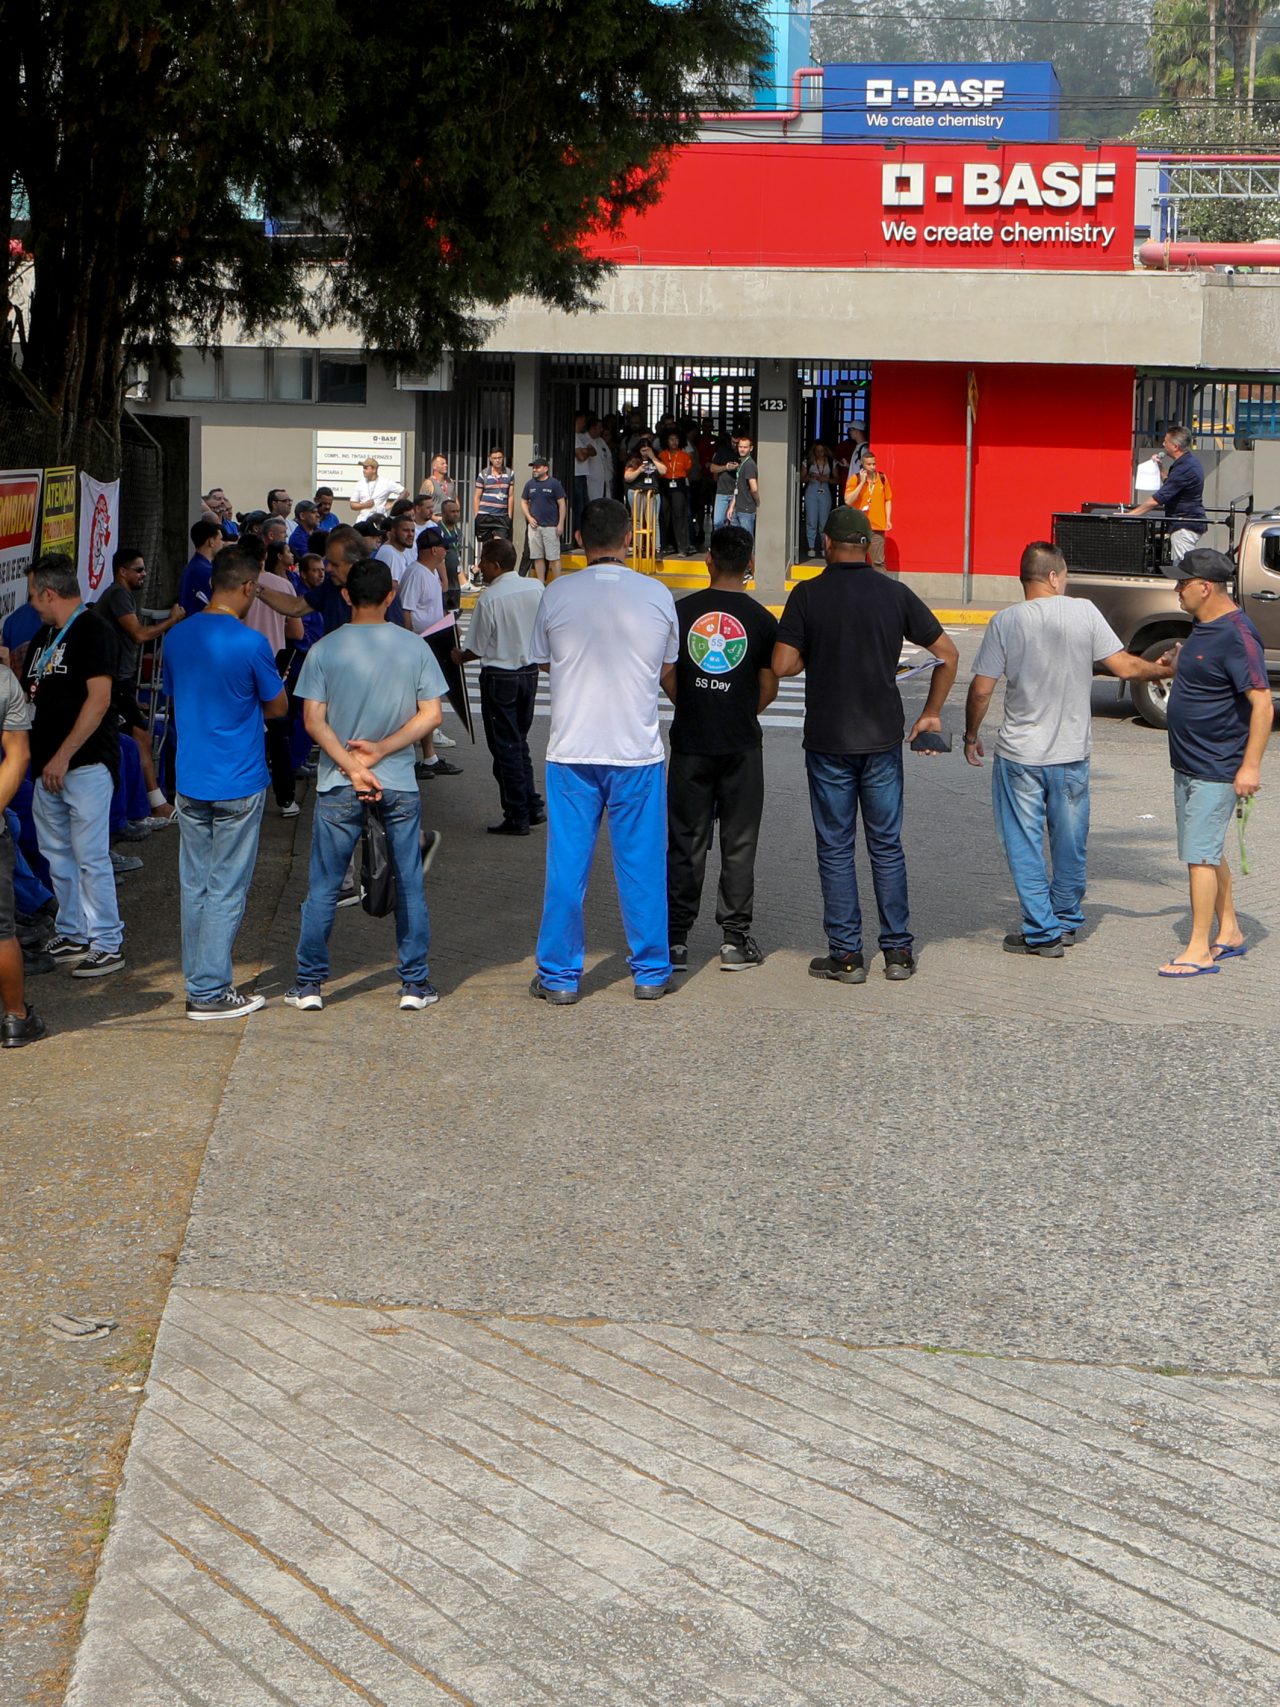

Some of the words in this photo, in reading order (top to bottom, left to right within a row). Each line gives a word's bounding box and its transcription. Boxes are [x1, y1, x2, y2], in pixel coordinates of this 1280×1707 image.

[913, 79, 1005, 108] BASF
[866, 114, 888, 128] We
[892, 114, 934, 128] create
[937, 113, 1004, 130] chemistry
[963, 161, 1117, 208] BASF
[881, 220, 917, 242] We
[923, 221, 994, 243] create
[1000, 221, 1116, 247] chemistry
[46, 475, 74, 513] ATENÇÃO
[695, 677, 709, 689] 5S
[710, 679, 731, 692] Day
